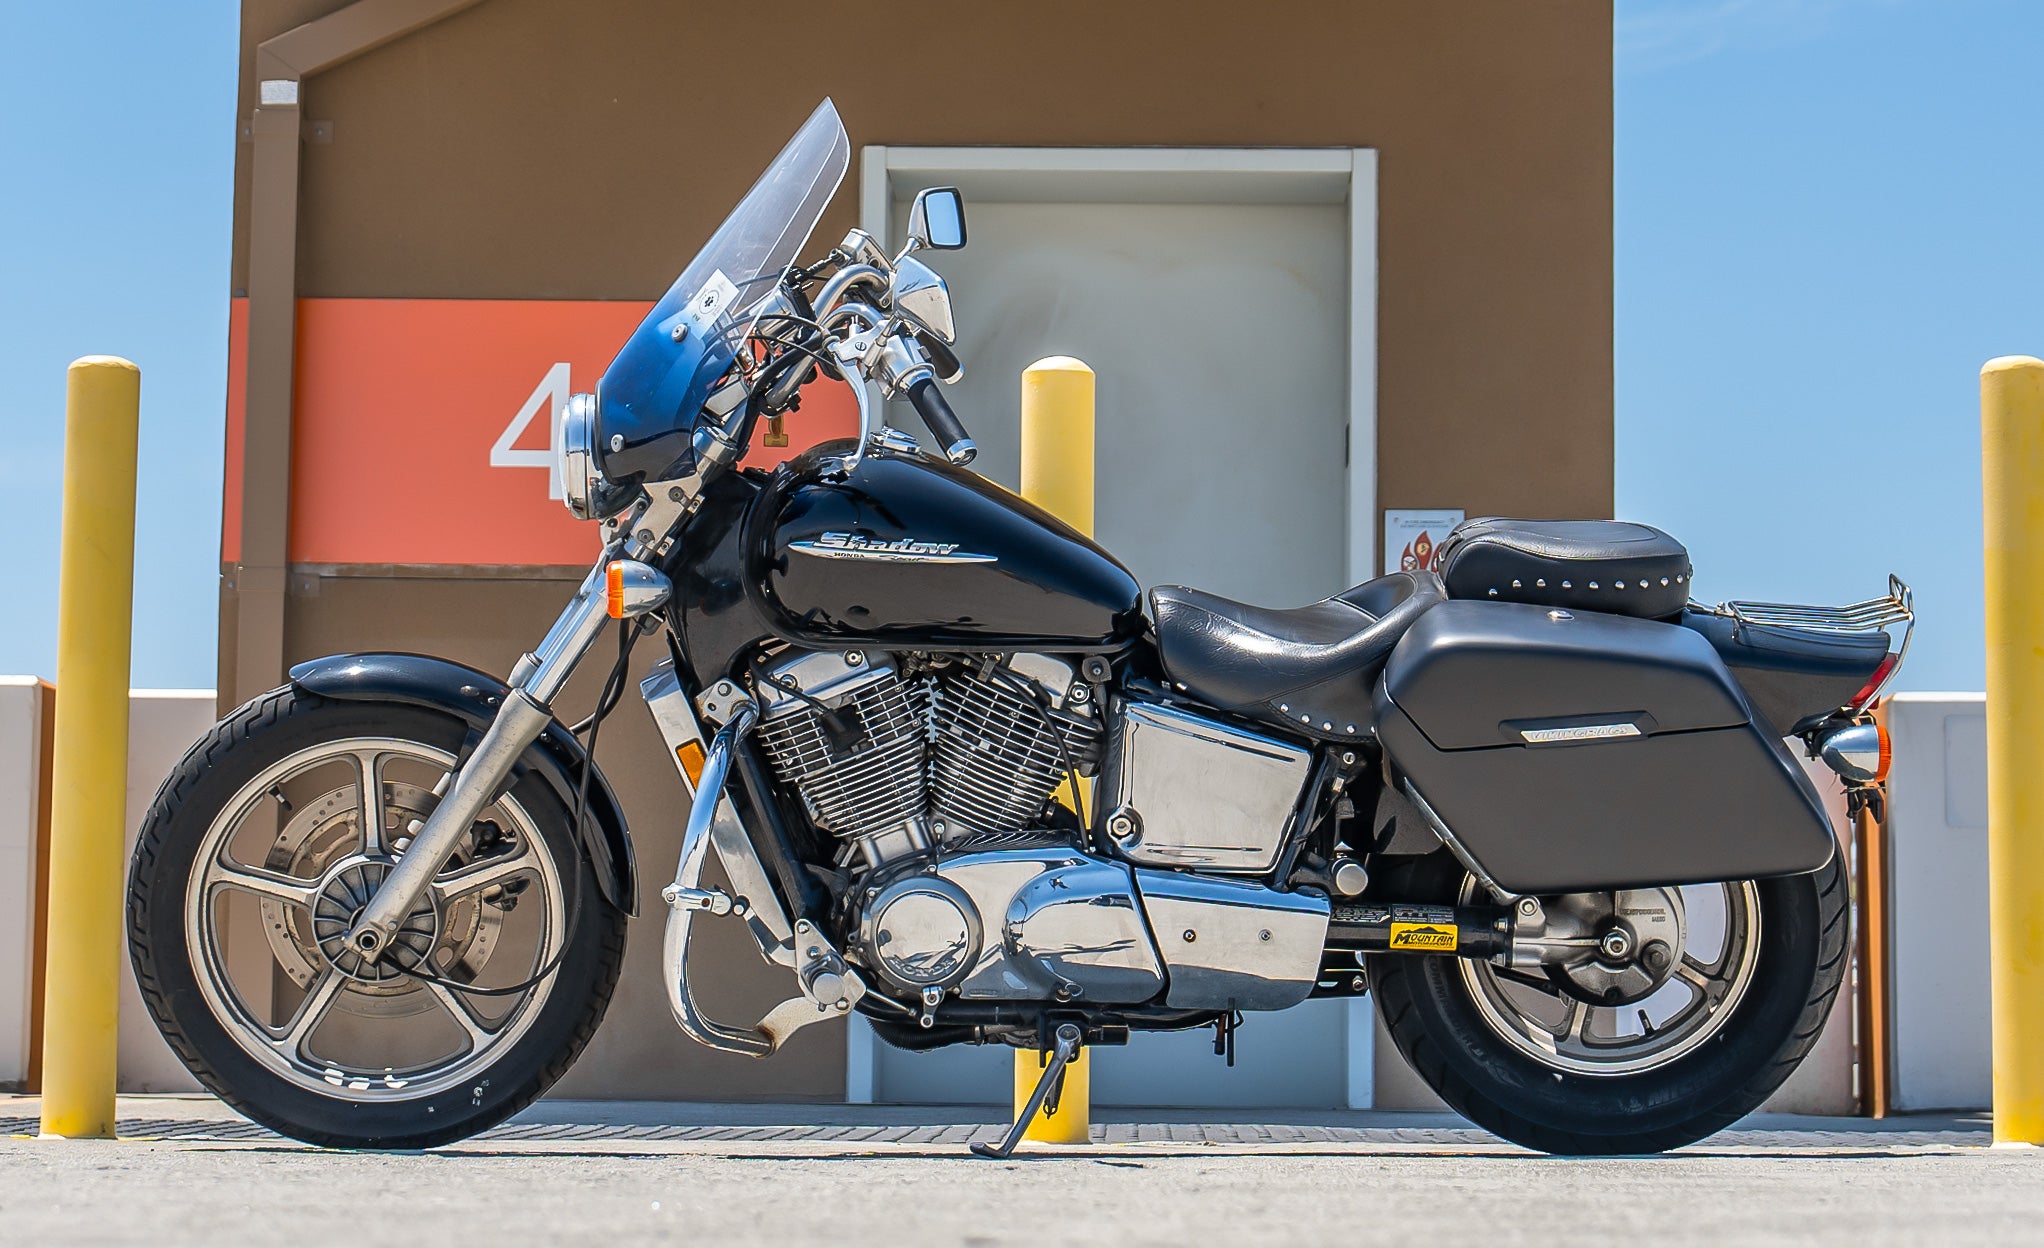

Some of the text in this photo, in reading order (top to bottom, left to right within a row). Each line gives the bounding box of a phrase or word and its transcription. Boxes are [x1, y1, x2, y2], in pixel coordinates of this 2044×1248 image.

[490, 362, 571, 500] 4
[813, 531, 960, 554] Shadow
[834, 551, 865, 559] HONDA
[1393, 933, 1455, 944] MOUNTAIN
